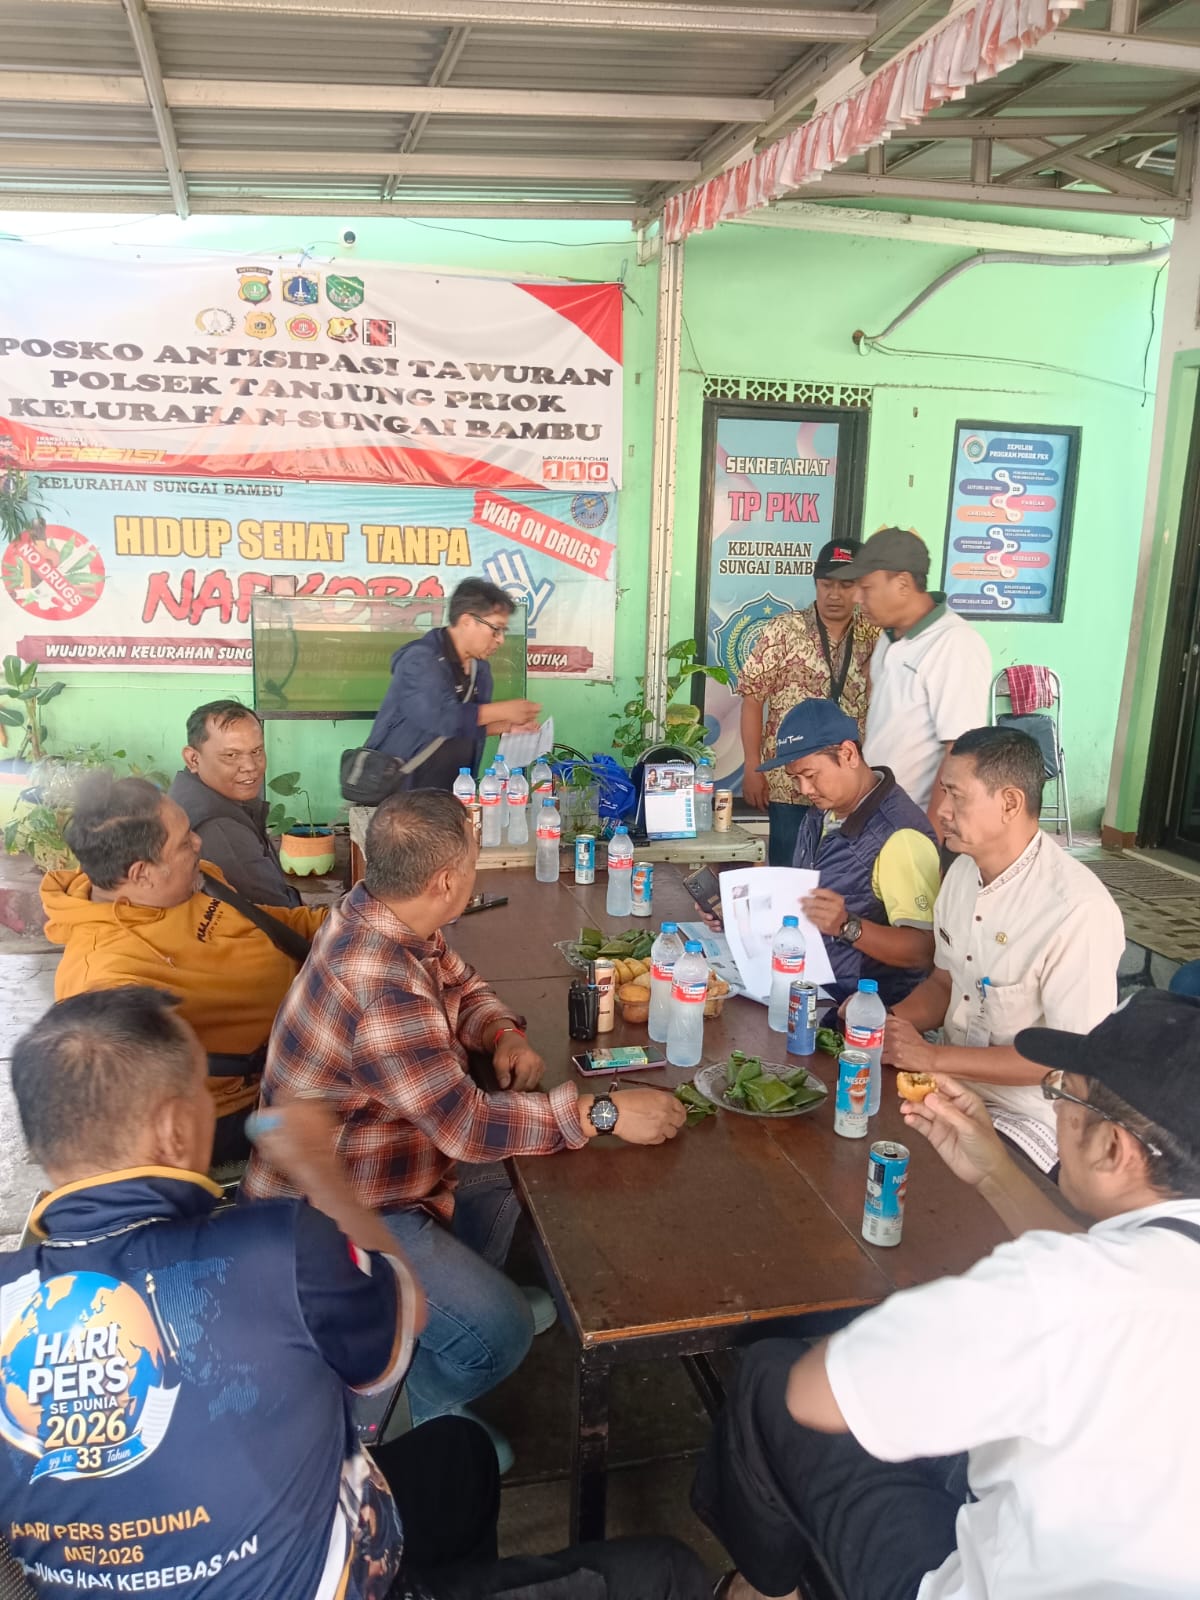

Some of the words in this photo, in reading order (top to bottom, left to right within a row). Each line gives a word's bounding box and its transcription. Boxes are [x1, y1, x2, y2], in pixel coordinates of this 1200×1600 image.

[0, 337, 144, 361] POSKO
[153, 344, 400, 376] ANTISIPASI
[408, 360, 613, 386] TAWURAN
[50, 369, 222, 395] POLSEK
[230, 377, 435, 406] TANJUNG
[445, 389, 566, 412] PRIOK
[8, 398, 288, 427] KELURAHAN
[297, 408, 457, 436] SUNGAI
[466, 419, 602, 441] BAMBU
[543, 462, 607, 479] 110
[725, 456, 829, 476] SEKRETARIAT
[38, 475, 148, 492] KELURAHAN
[153, 479, 219, 495] SUNGAI
[224, 482, 284, 497] BAMBU
[728, 491, 761, 521] TP
[766, 492, 820, 523] PKK
[114, 515, 232, 558] HIDUP
[237, 519, 350, 561] SEHAT
[361, 524, 472, 567] TANPA
[481, 499, 520, 534] WAR
[524, 516, 548, 545] ON
[545, 527, 601, 569] DRUGS
[728, 541, 812, 557] KELURAHAN
[19, 543, 41, 565] NO
[39, 561, 83, 606] DRUGS
[719, 559, 770, 575] SUNGAI
[774, 560, 817, 576] BAMB
[45, 644, 127, 659] WUJUDKAN
[131, 645, 214, 661] KELURAHAN
[217, 646, 252, 661] SUNG
[526, 653, 568, 667] KOTIKA
[34, 1322, 121, 1367] HARI
[28, 1357, 130, 1404] PERS
[50, 1403, 68, 1415] SE
[73, 1396, 119, 1413] DUNIA
[44, 1408, 127, 1449] 2026
[76, 1448, 101, 1470] 33
[106, 1448, 131, 1463] Tahun
[11, 1521, 49, 1541] HARI
[53, 1522, 105, 1541] PERS
[109, 1505, 211, 1542] SEDUNIA
[64, 1545, 96, 1564] MEI
[98, 1545, 145, 1566] 2026
[77, 1569, 114, 1590] HAK
[117, 1534, 259, 1592] KEBEBASAN
